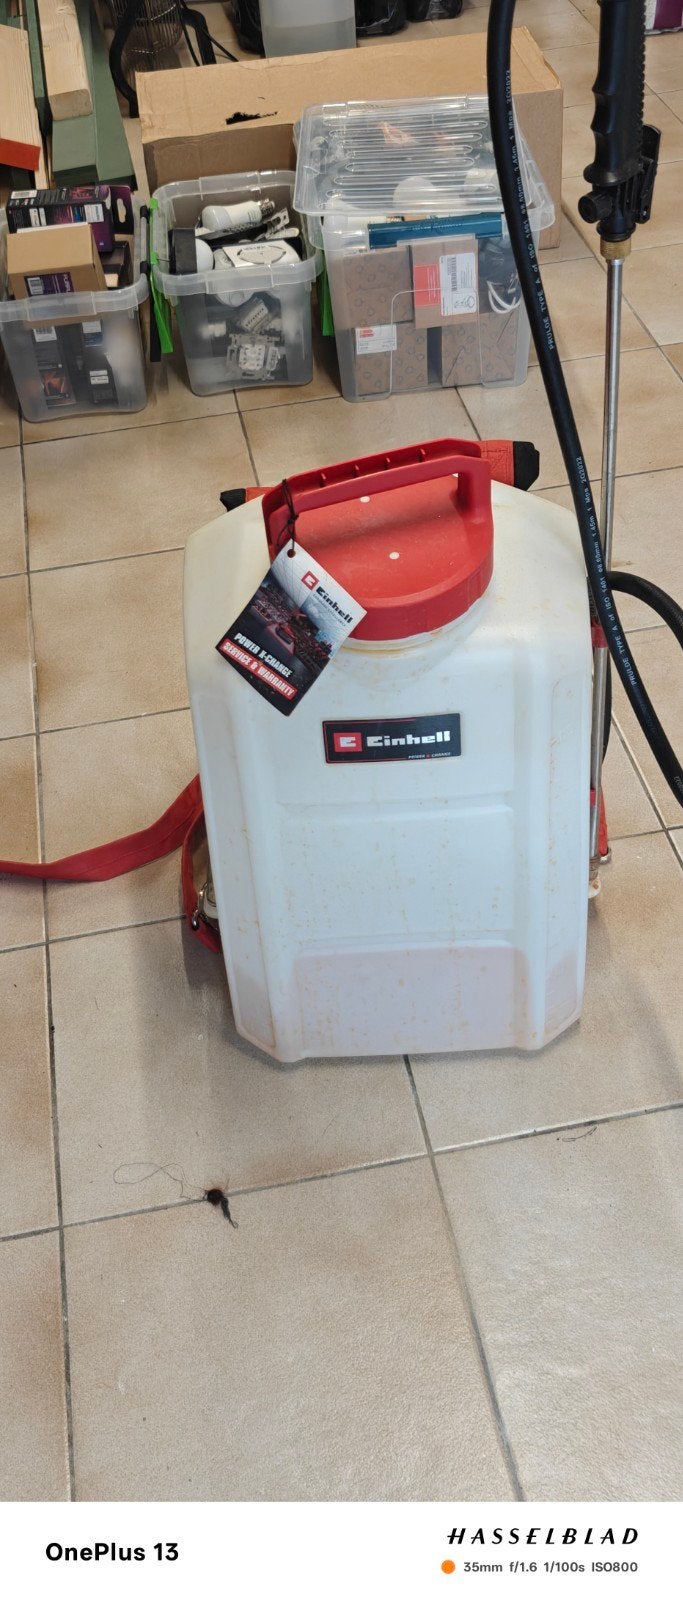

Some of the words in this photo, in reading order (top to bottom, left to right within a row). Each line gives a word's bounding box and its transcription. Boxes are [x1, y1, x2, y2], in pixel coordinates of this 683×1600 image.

[537, 290, 546, 312] TYPE
[316, 586, 353, 623] Einhell
[604, 597, 612, 610] ISO
[608, 613, 616, 621] of
[234, 632, 260, 655] POWER
[258, 650, 293, 678] X-CHANGE
[614, 635, 625, 653] TYPE
[223, 642, 253, 665] SERVICE
[251, 661, 259, 670] &
[258, 666, 295, 696] WARRANTY
[623, 657, 637, 686] PRULDE
[366, 730, 451, 747] Einhell
